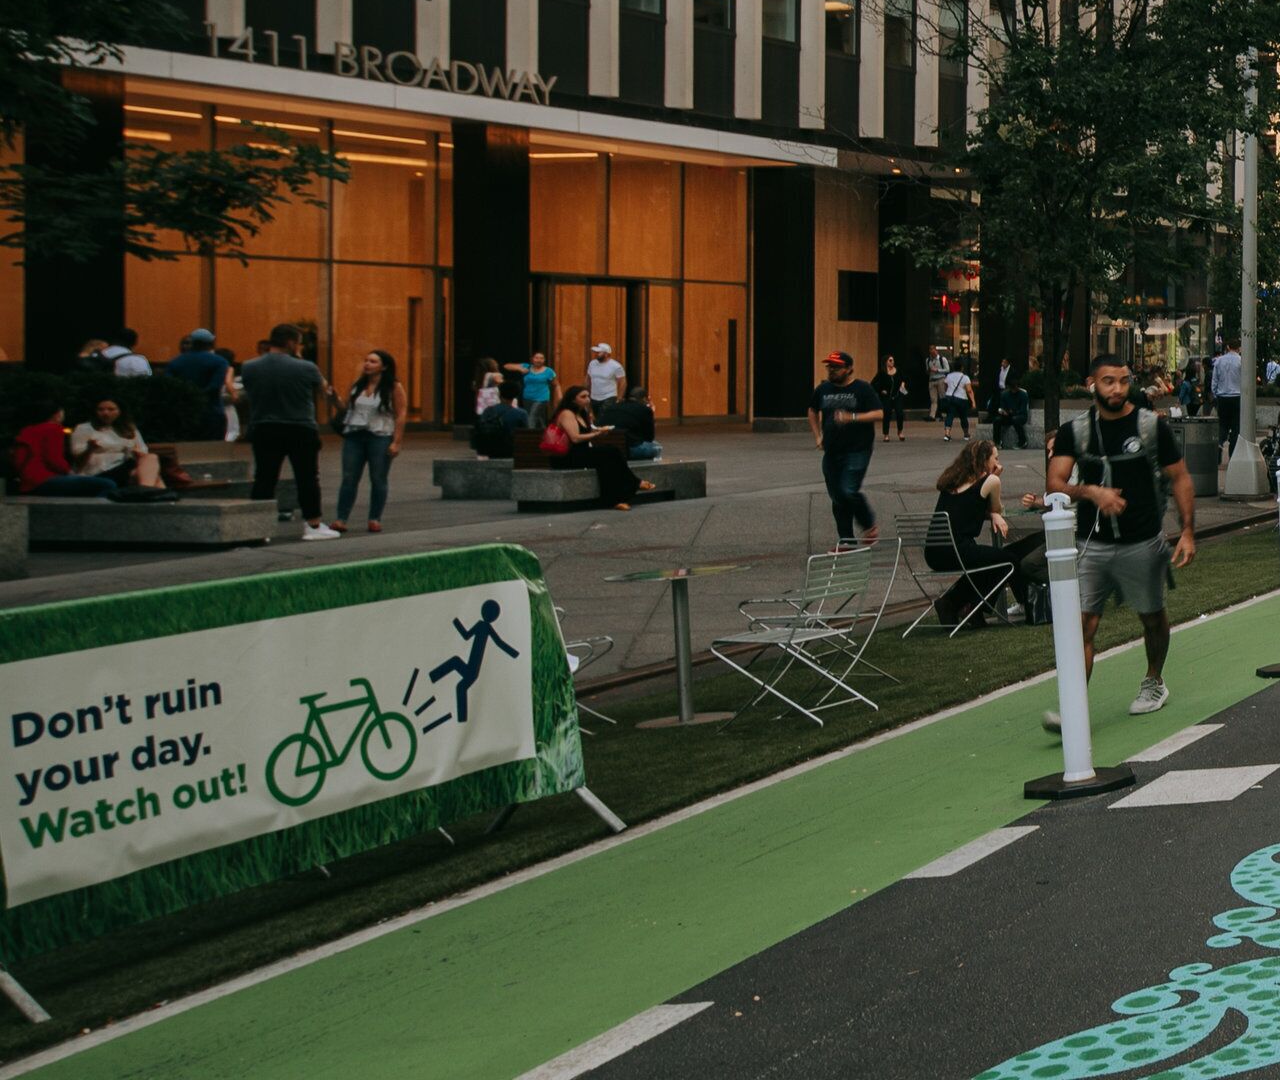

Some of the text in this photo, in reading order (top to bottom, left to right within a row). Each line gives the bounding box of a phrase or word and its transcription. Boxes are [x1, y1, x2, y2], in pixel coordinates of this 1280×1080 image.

[202, 22, 558, 105] 1411 BROADWAY
[11, 678, 222, 748] Don't ruin
[15, 732, 211, 806] your day.
[19, 763, 248, 850] Watch out!
